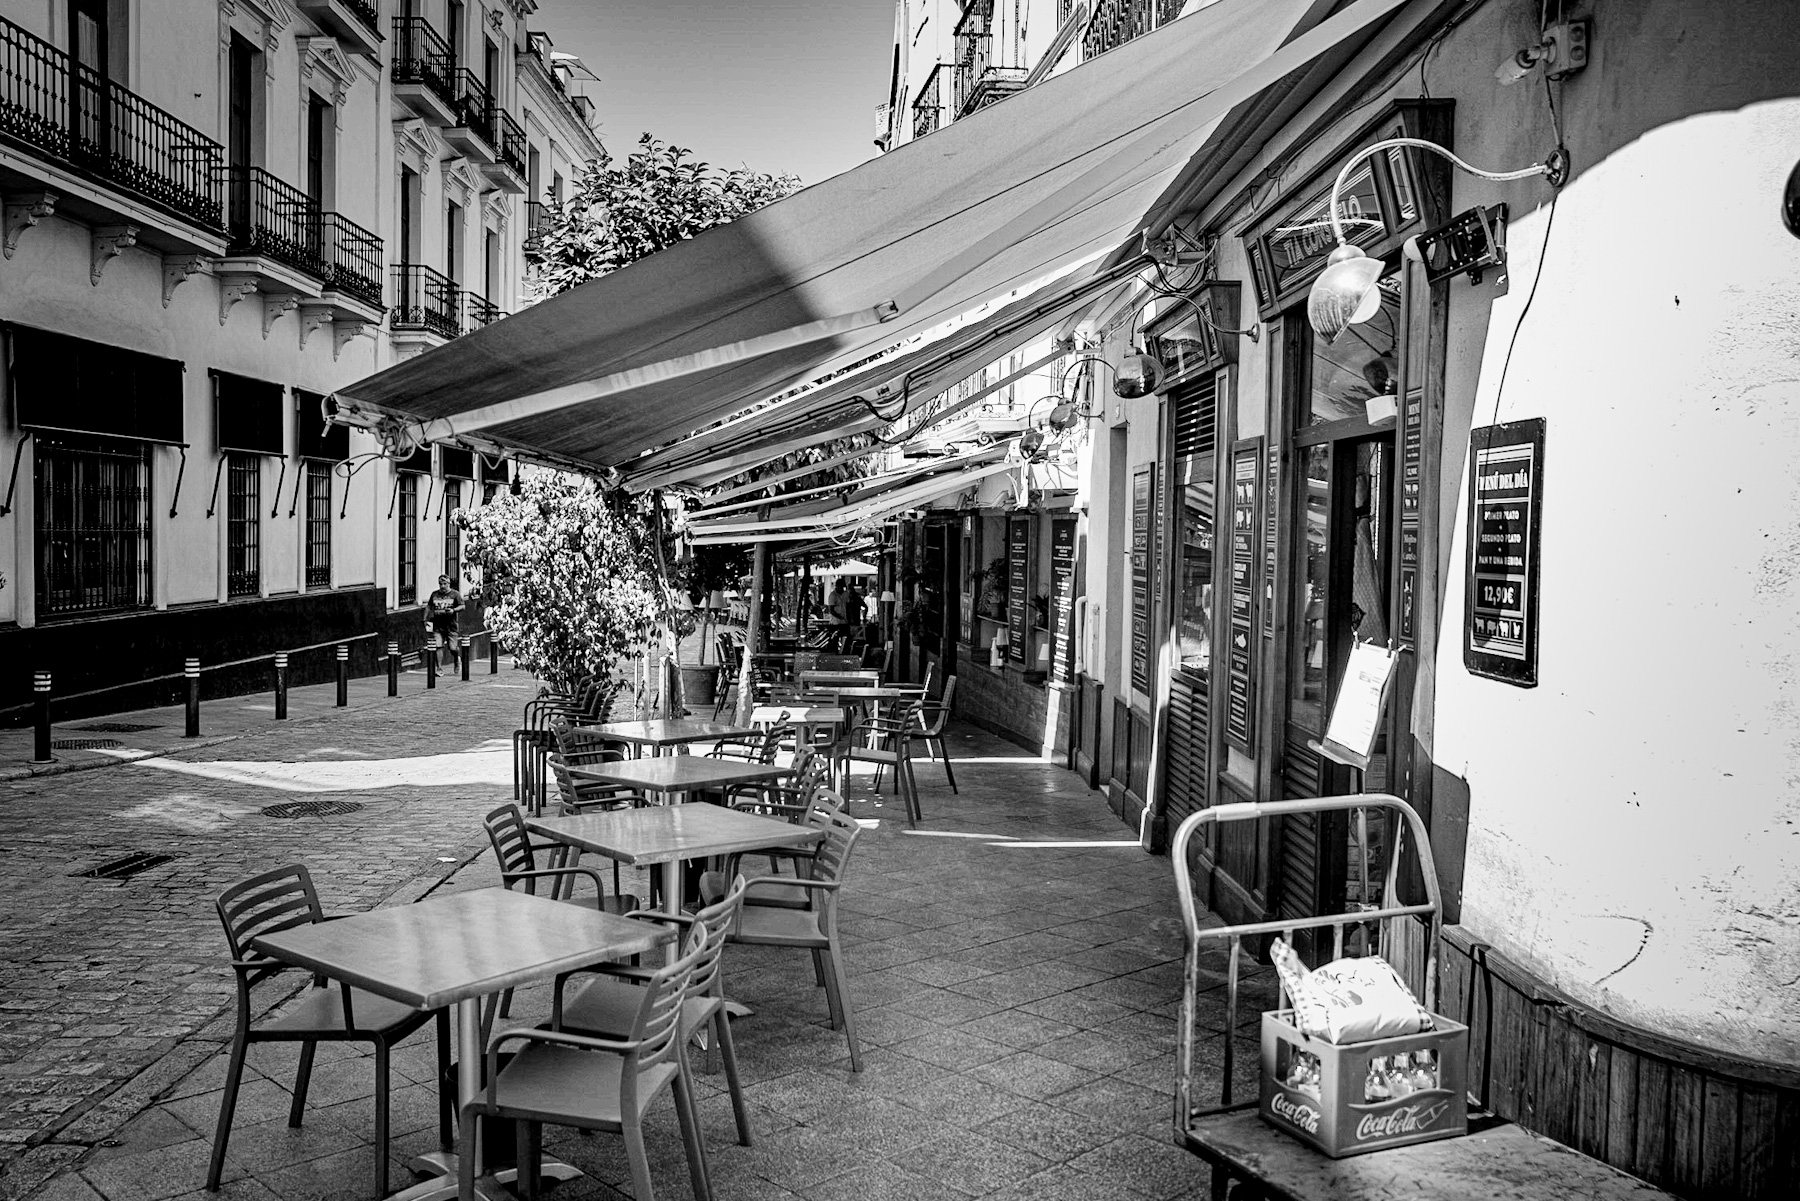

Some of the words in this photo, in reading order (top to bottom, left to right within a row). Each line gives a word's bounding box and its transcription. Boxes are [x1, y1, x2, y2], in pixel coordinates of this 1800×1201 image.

[1479, 470, 1499, 491] MENÚ
[1498, 473, 1514, 490] DEL
[1514, 468, 1528, 489] DÍA
[1484, 511, 1502, 520] PRIMER
[1503, 510, 1519, 520] PLATO
[1481, 533, 1504, 543] SEGUNDO
[1504, 533, 1521, 543] PLATO
[1478, 555, 1488, 565] PAN
[1488, 556, 1493, 565] Y
[1493, 556, 1503, 565] UNA
[1503, 556, 1523, 567] BEBIDA
[1484, 585, 1515, 606] 12,90€
